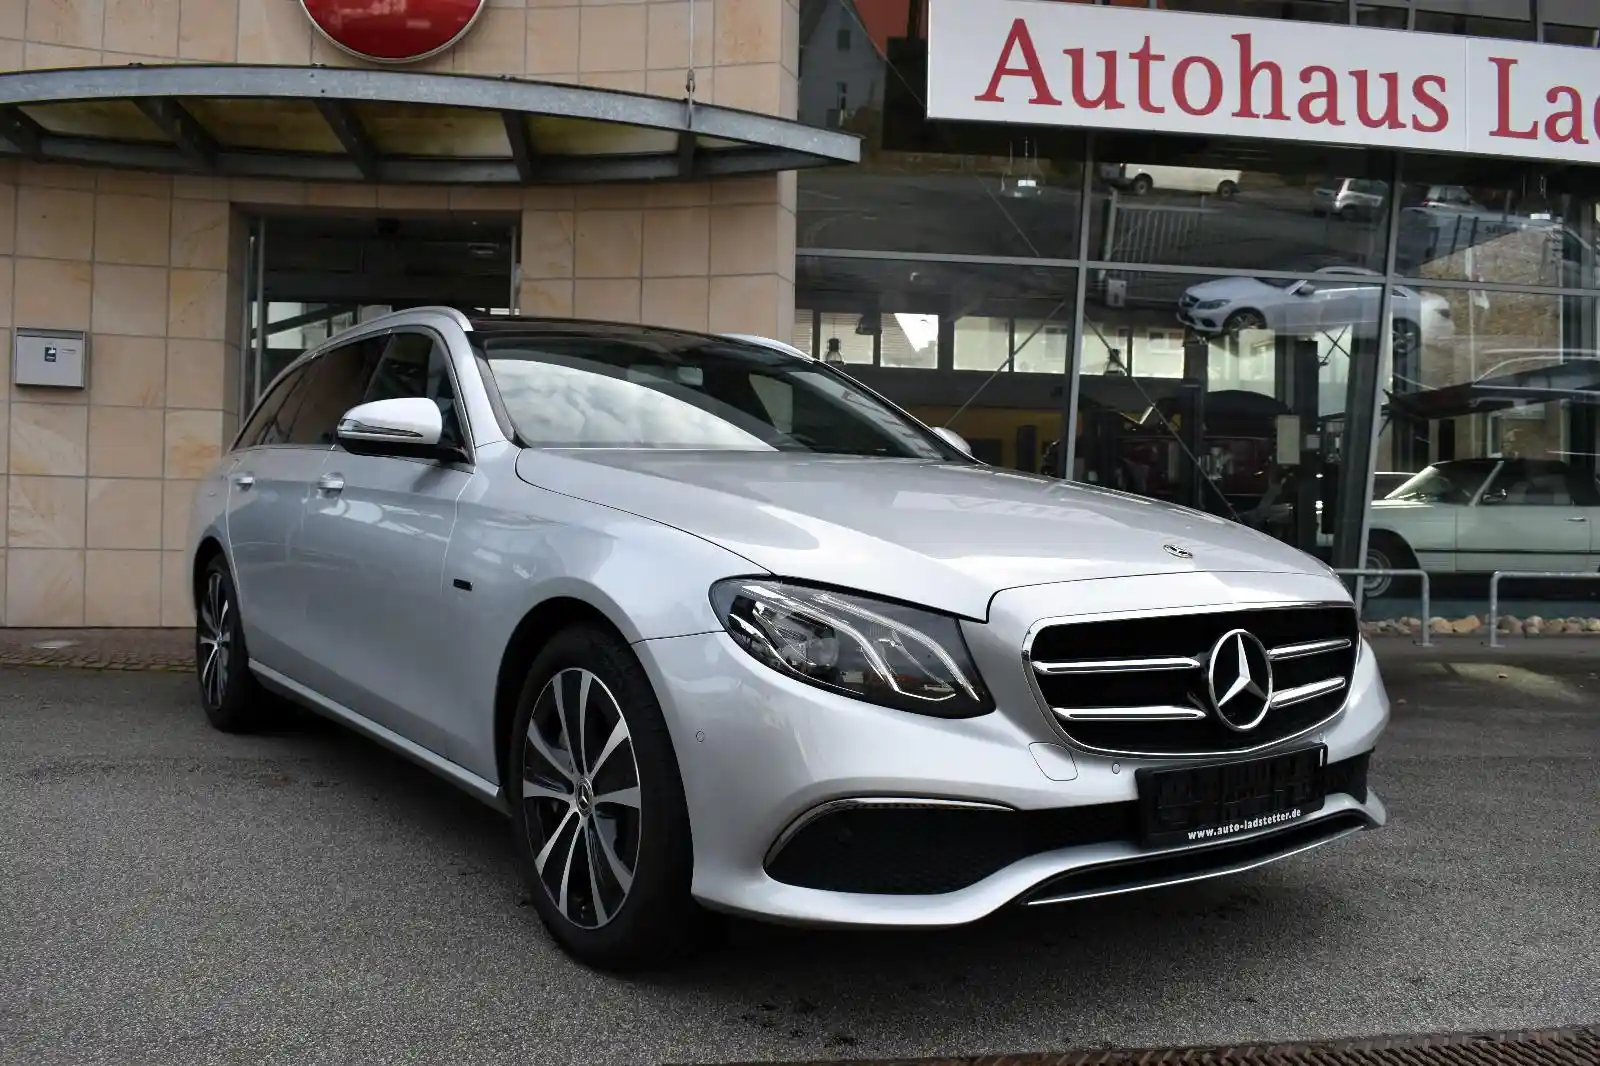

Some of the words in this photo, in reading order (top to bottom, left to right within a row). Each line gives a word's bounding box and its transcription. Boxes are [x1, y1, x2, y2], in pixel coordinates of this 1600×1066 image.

[974, 18, 1449, 133] Autohaus
[1488, 56, 1600, 145] La
[1187, 808, 1301, 840] www.auto-ladstetter.de
